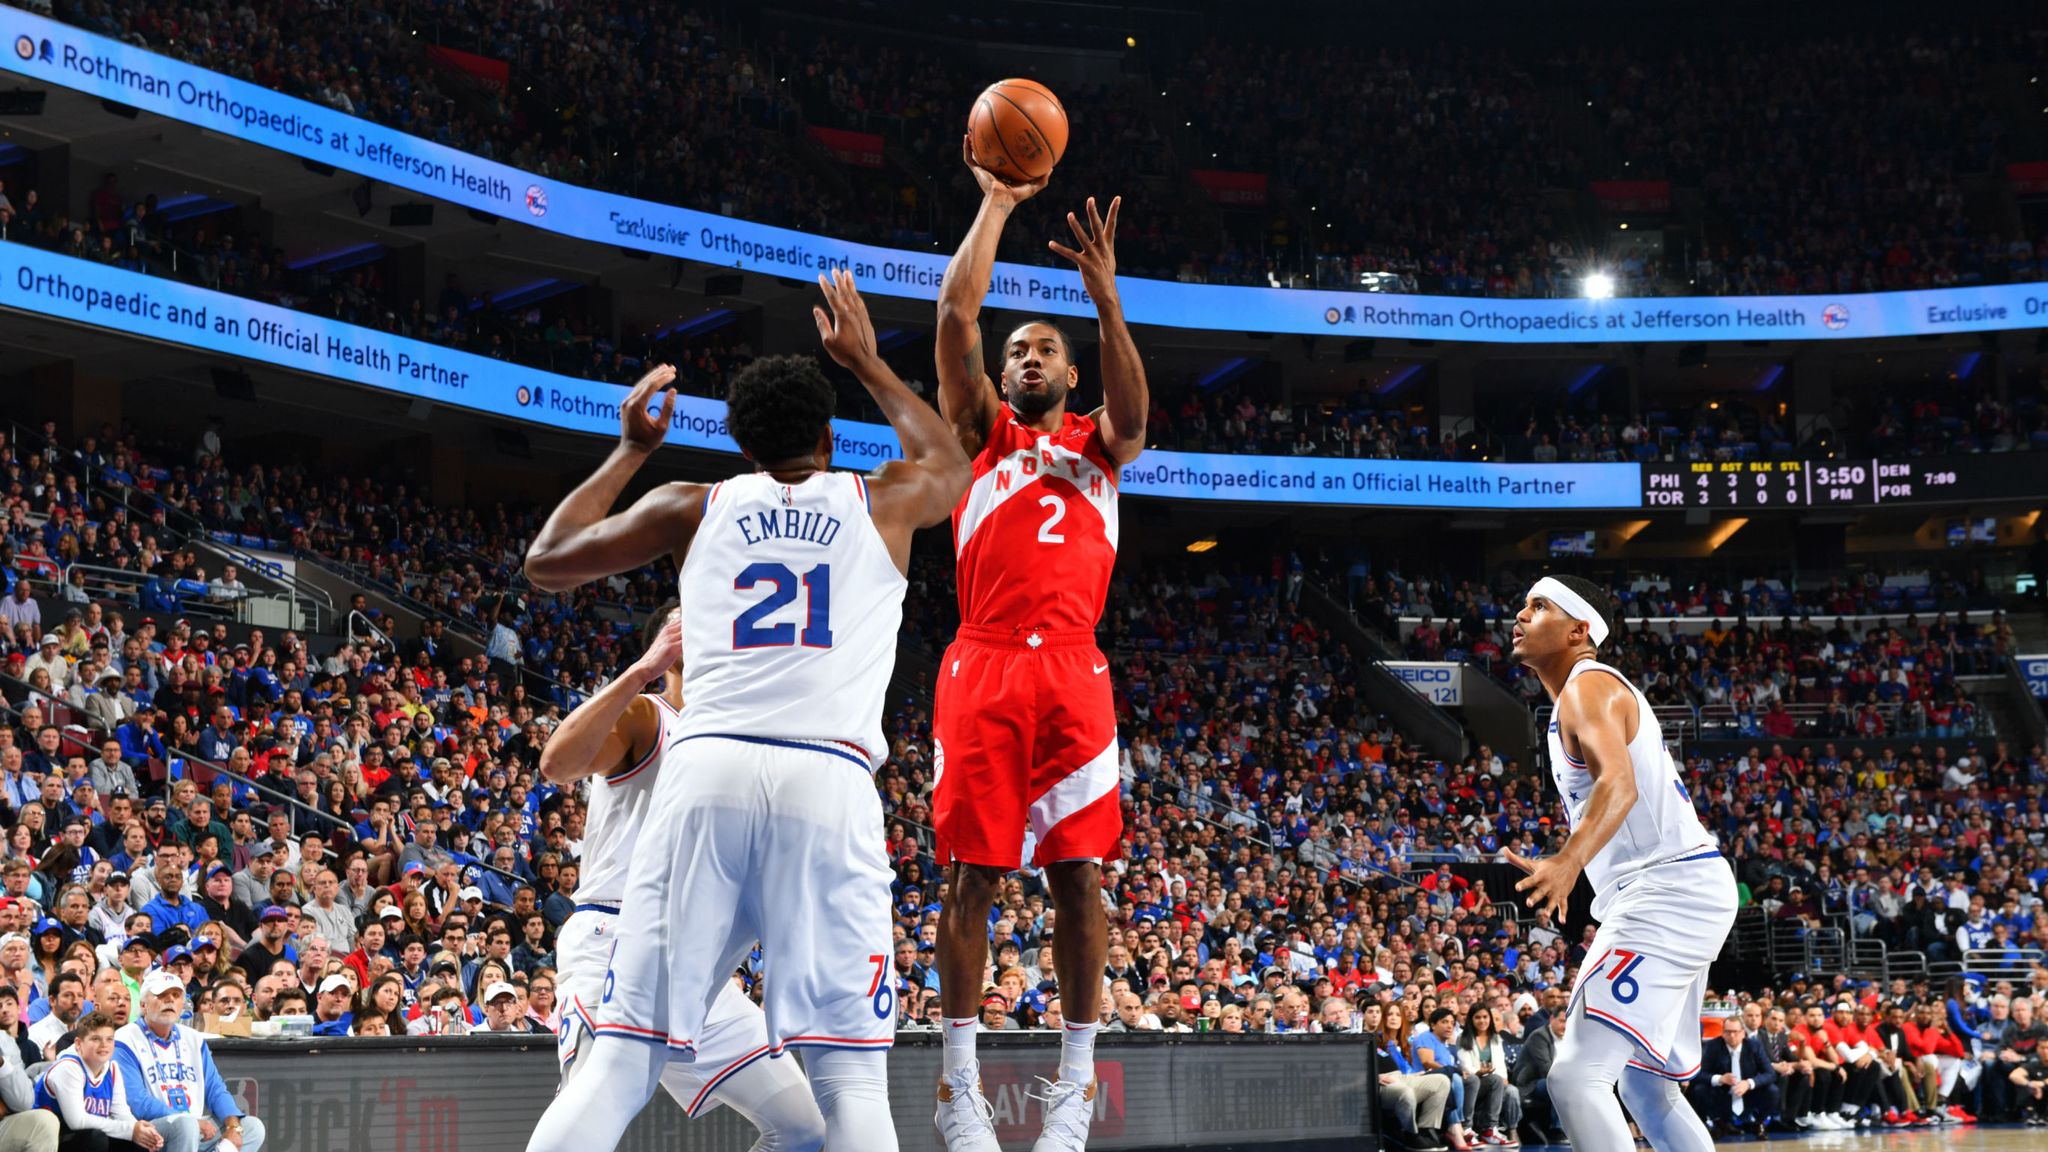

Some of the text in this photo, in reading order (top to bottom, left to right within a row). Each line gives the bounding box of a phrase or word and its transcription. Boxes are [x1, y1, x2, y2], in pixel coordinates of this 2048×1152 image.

[63, 44, 512, 203] Rothman Orthopaedics at Jefferson Health
[700, 227, 813, 268] Orthopaedic
[855, 261, 876, 279] an
[883, 261, 944, 288] Officia
[989, 275, 1021, 297] alth
[1028, 279, 1092, 305] Partne
[1364, 305, 1454, 328] Rothman
[1459, 309, 1599, 334] Orthopaedics
[1605, 314, 1625, 329] at
[1632, 309, 1730, 329] Jefferson
[1737, 308, 1806, 327] Health
[1927, 303, 2008, 324] Exclusive
[17, 266, 470, 389] Orthopaedic and an Official Health Partner
[550, 389, 622, 421] Rothma
[833, 433, 893, 459] ferson
[995, 449, 1102, 497] NORTH
[1720, 462, 1743, 472] AST
[1750, 462, 1773, 472] BLK
[1780, 462, 1801, 472] STL
[1816, 466, 1865, 485] 3:50
[1879, 464, 1911, 477] DEN
[1924, 472, 1957, 485] 7:00
[1322, 474, 1346, 490] an
[1352, 471, 1421, 493] Official
[1428, 474, 1491, 494] Health
[1498, 476, 1576, 495] Partner
[1650, 473, 1796, 488] PHI 4 3 0 1
[1880, 485, 1912, 497] POR
[1646, 489, 1797, 506] TOR 3 1 0 0
[1830, 488, 1853, 500] PM
[736, 508, 841, 546] EMBIID
[1037, 494, 1067, 544] 2
[732, 562, 833, 651] 21
[1434, 687, 1457, 703] 121
[866, 955, 894, 1020] 76
[1606, 949, 1646, 1004] 76
[147, 1062, 197, 1084] SXERS
[993, 1083, 1032, 1126] AY
